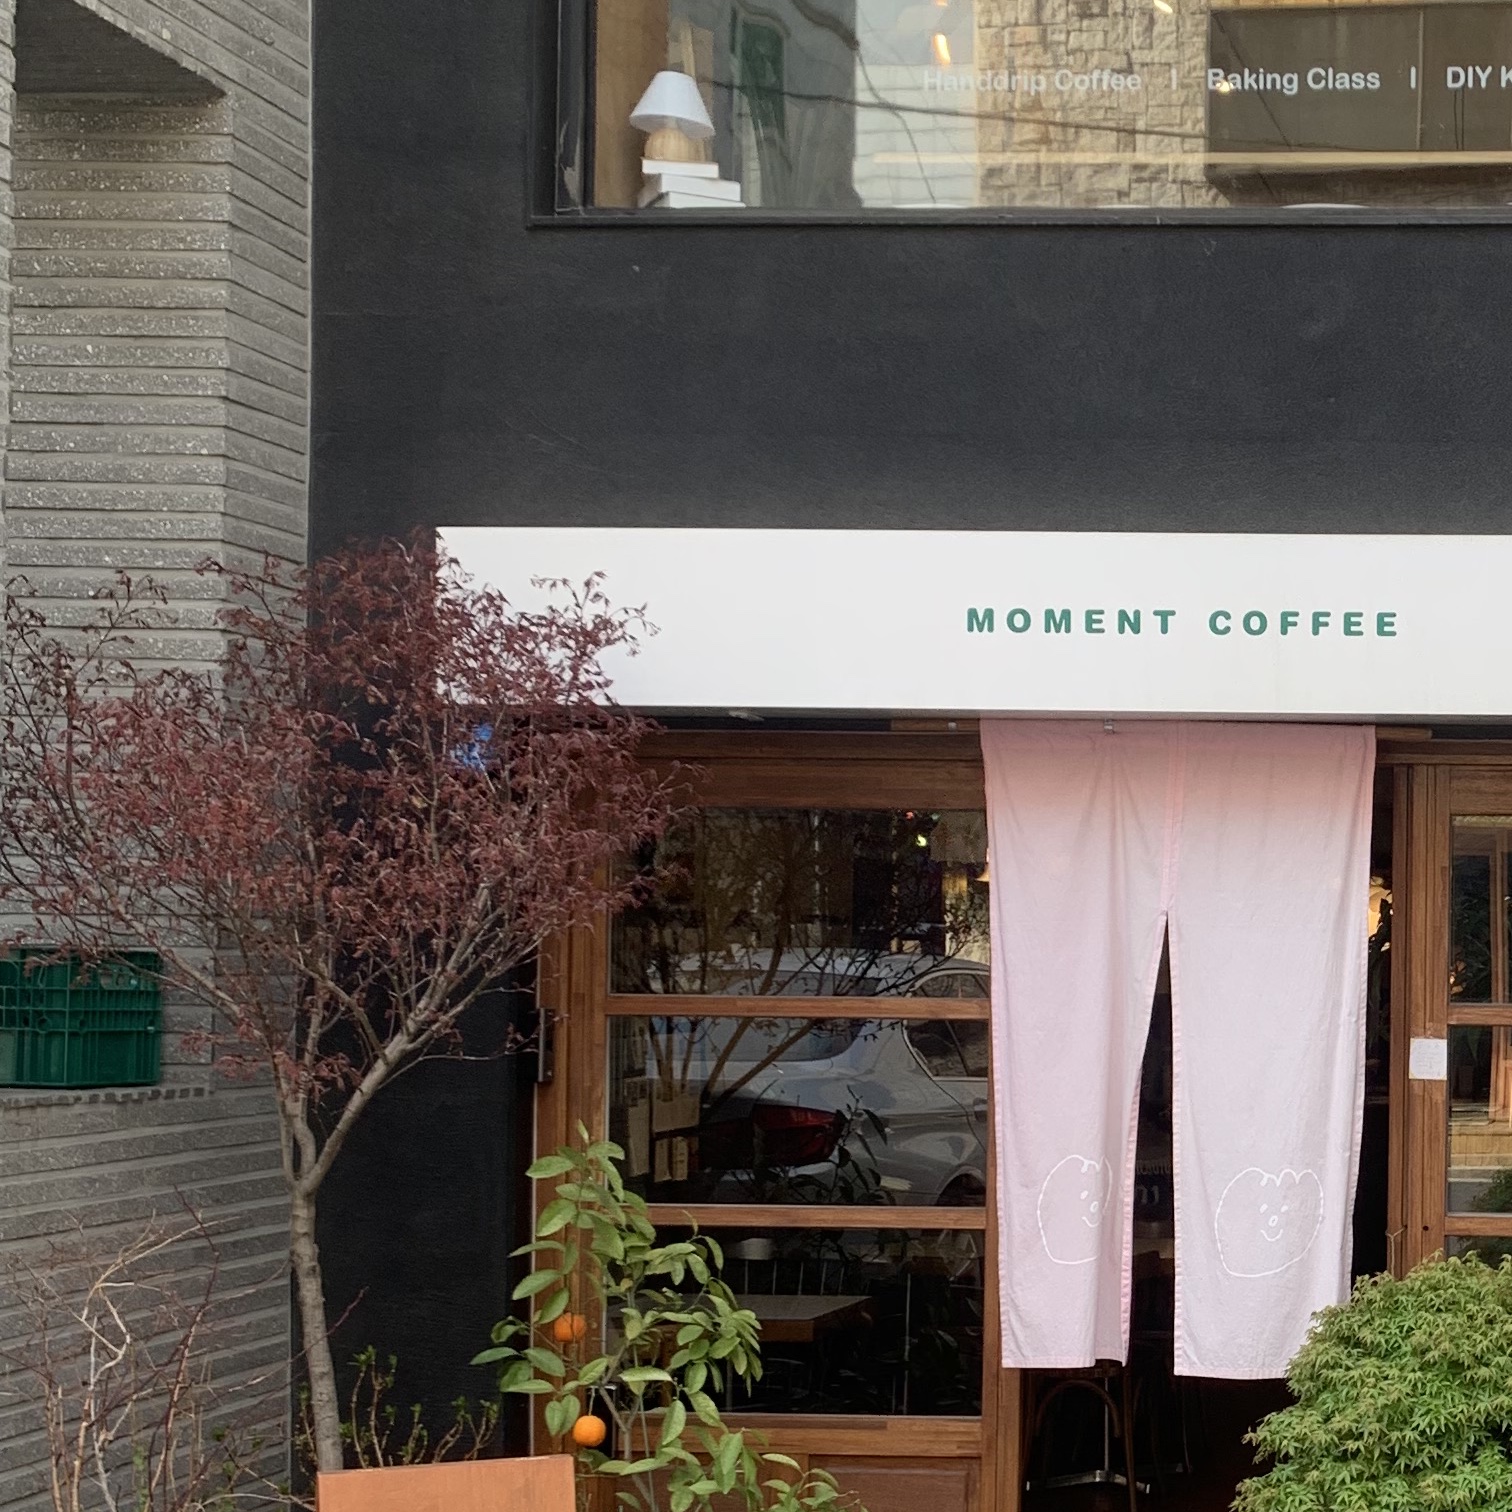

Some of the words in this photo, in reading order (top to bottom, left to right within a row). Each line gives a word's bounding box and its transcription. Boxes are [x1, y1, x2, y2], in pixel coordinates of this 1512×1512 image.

[1054, 69, 1142, 91] Coffee
[1207, 67, 1299, 95] Baking
[1307, 67, 1380, 90] Class
[1446, 66, 1493, 88] DIY
[967, 607, 1176, 635] MOMENT
[1208, 609, 1397, 637] COFFEE
